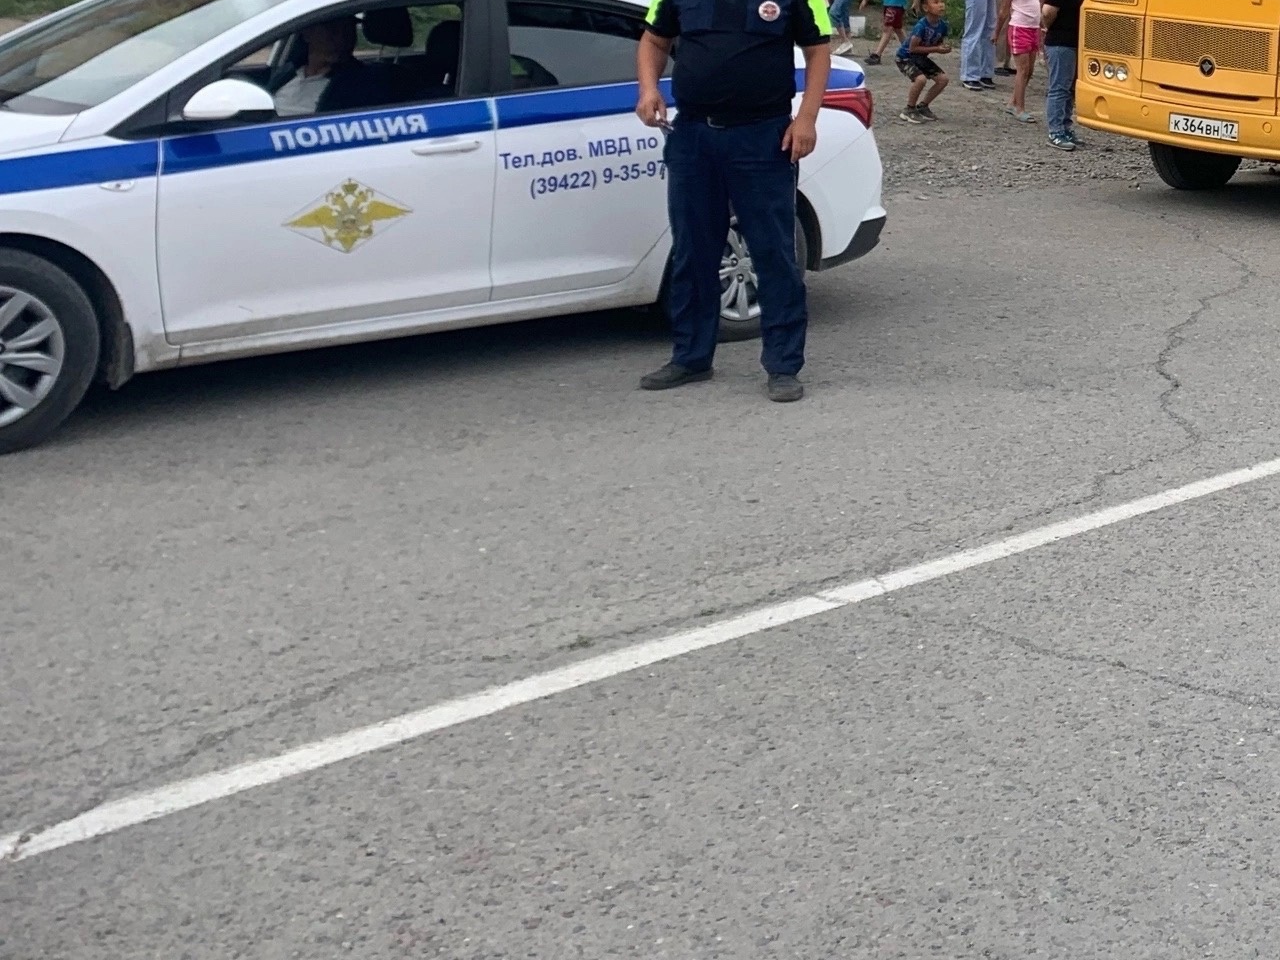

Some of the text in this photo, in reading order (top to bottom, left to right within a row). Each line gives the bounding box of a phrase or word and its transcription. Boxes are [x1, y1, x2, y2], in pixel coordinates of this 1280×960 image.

[269, 113, 429, 152] ПОЛИЦИЯ
[1223, 123, 1235, 135] 17
[499, 136, 659, 170] Тел.дов. МВД по
[529, 169, 598, 200] (39422)
